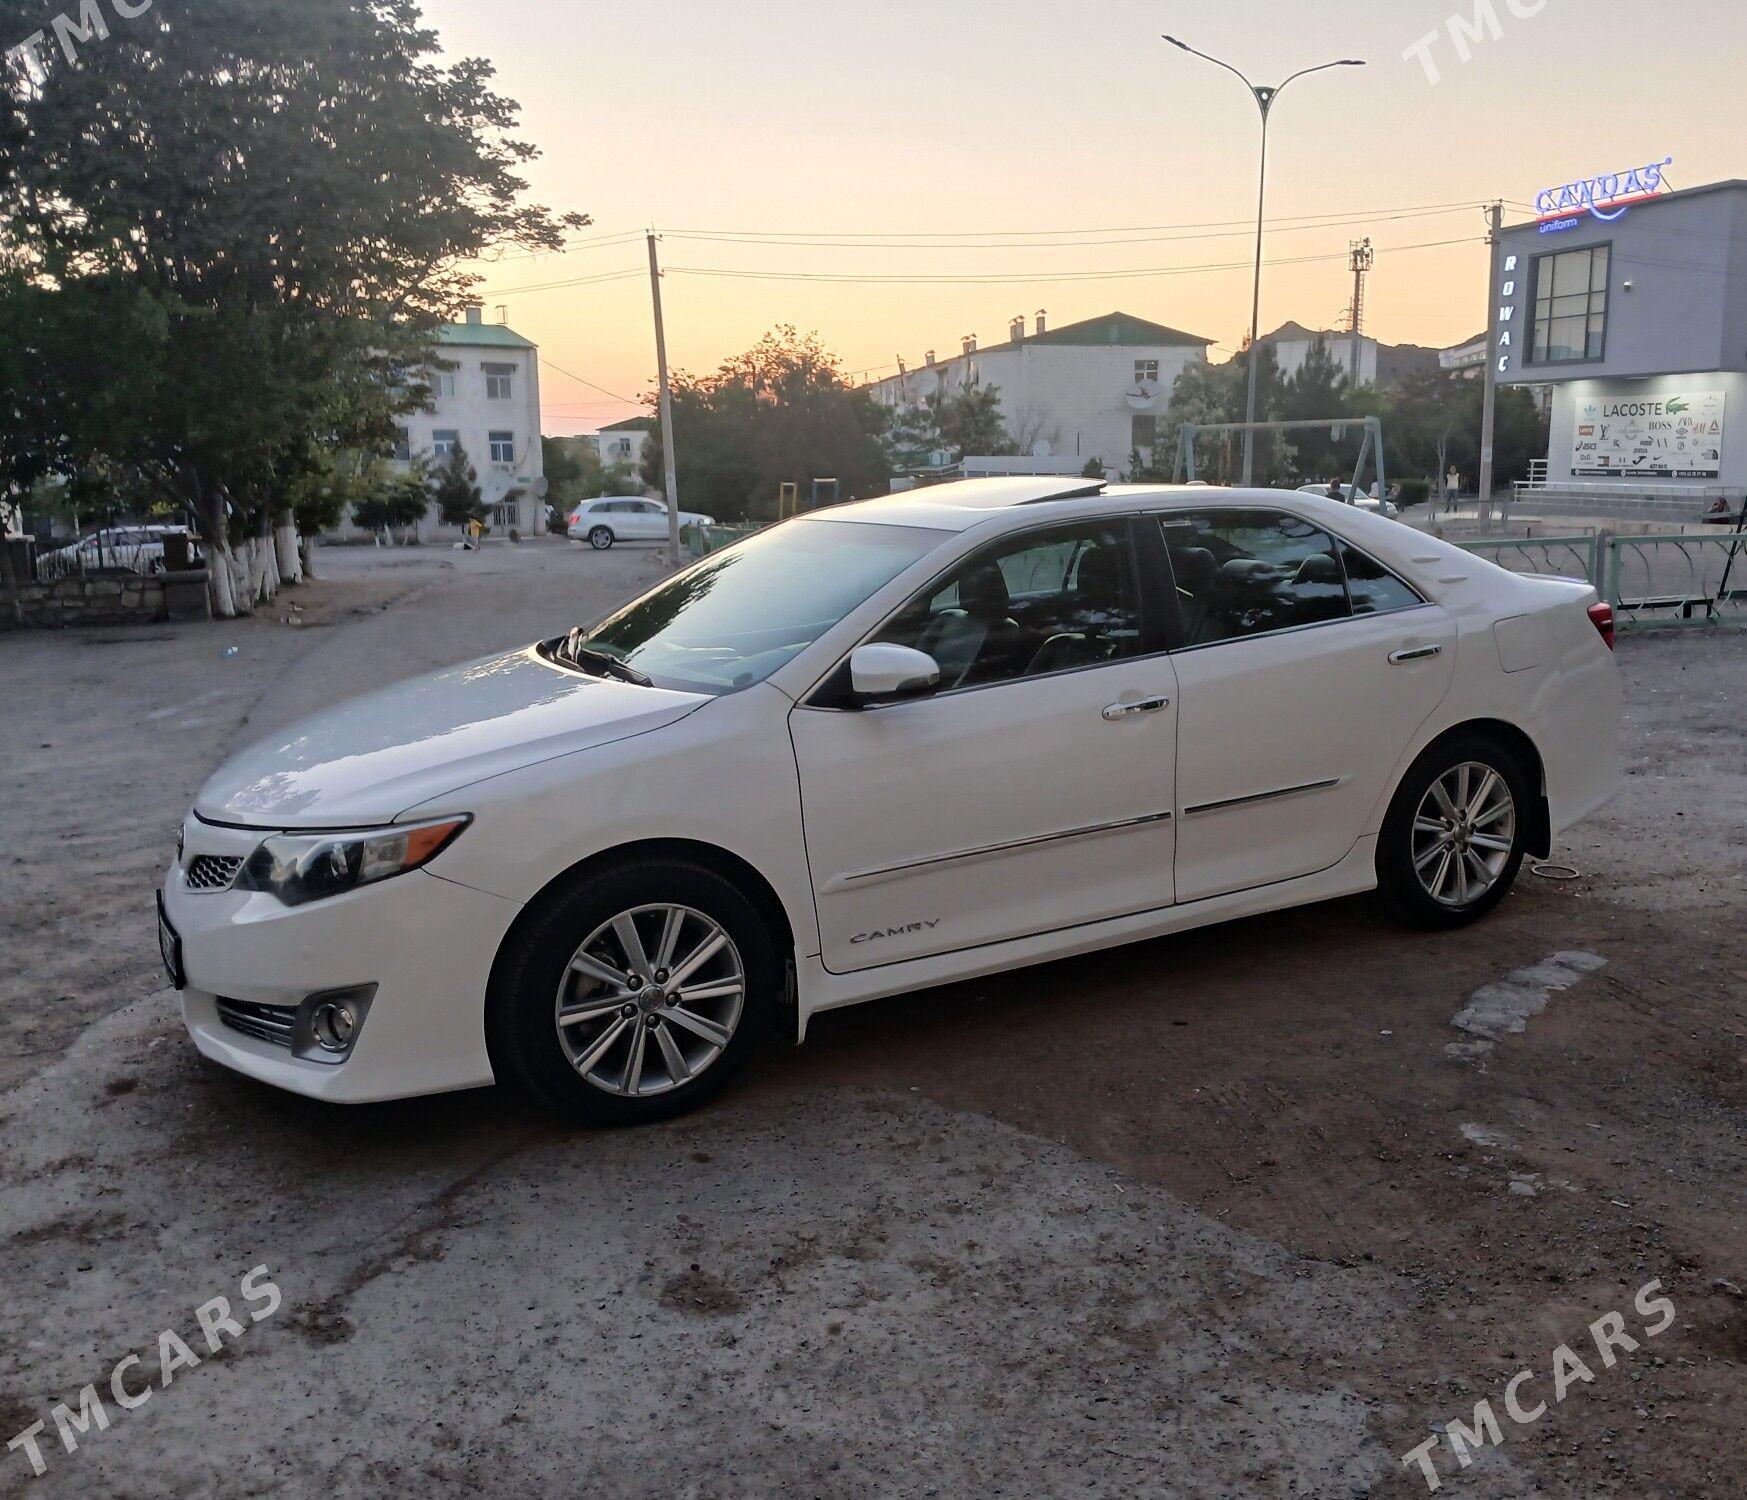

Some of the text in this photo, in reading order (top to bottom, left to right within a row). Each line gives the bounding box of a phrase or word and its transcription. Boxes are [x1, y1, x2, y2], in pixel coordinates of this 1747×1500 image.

[1603, 402, 1663, 418] LACOSTE
[1648, 420, 1672, 431] BOSS
[850, 918, 940, 944] CAMRY
